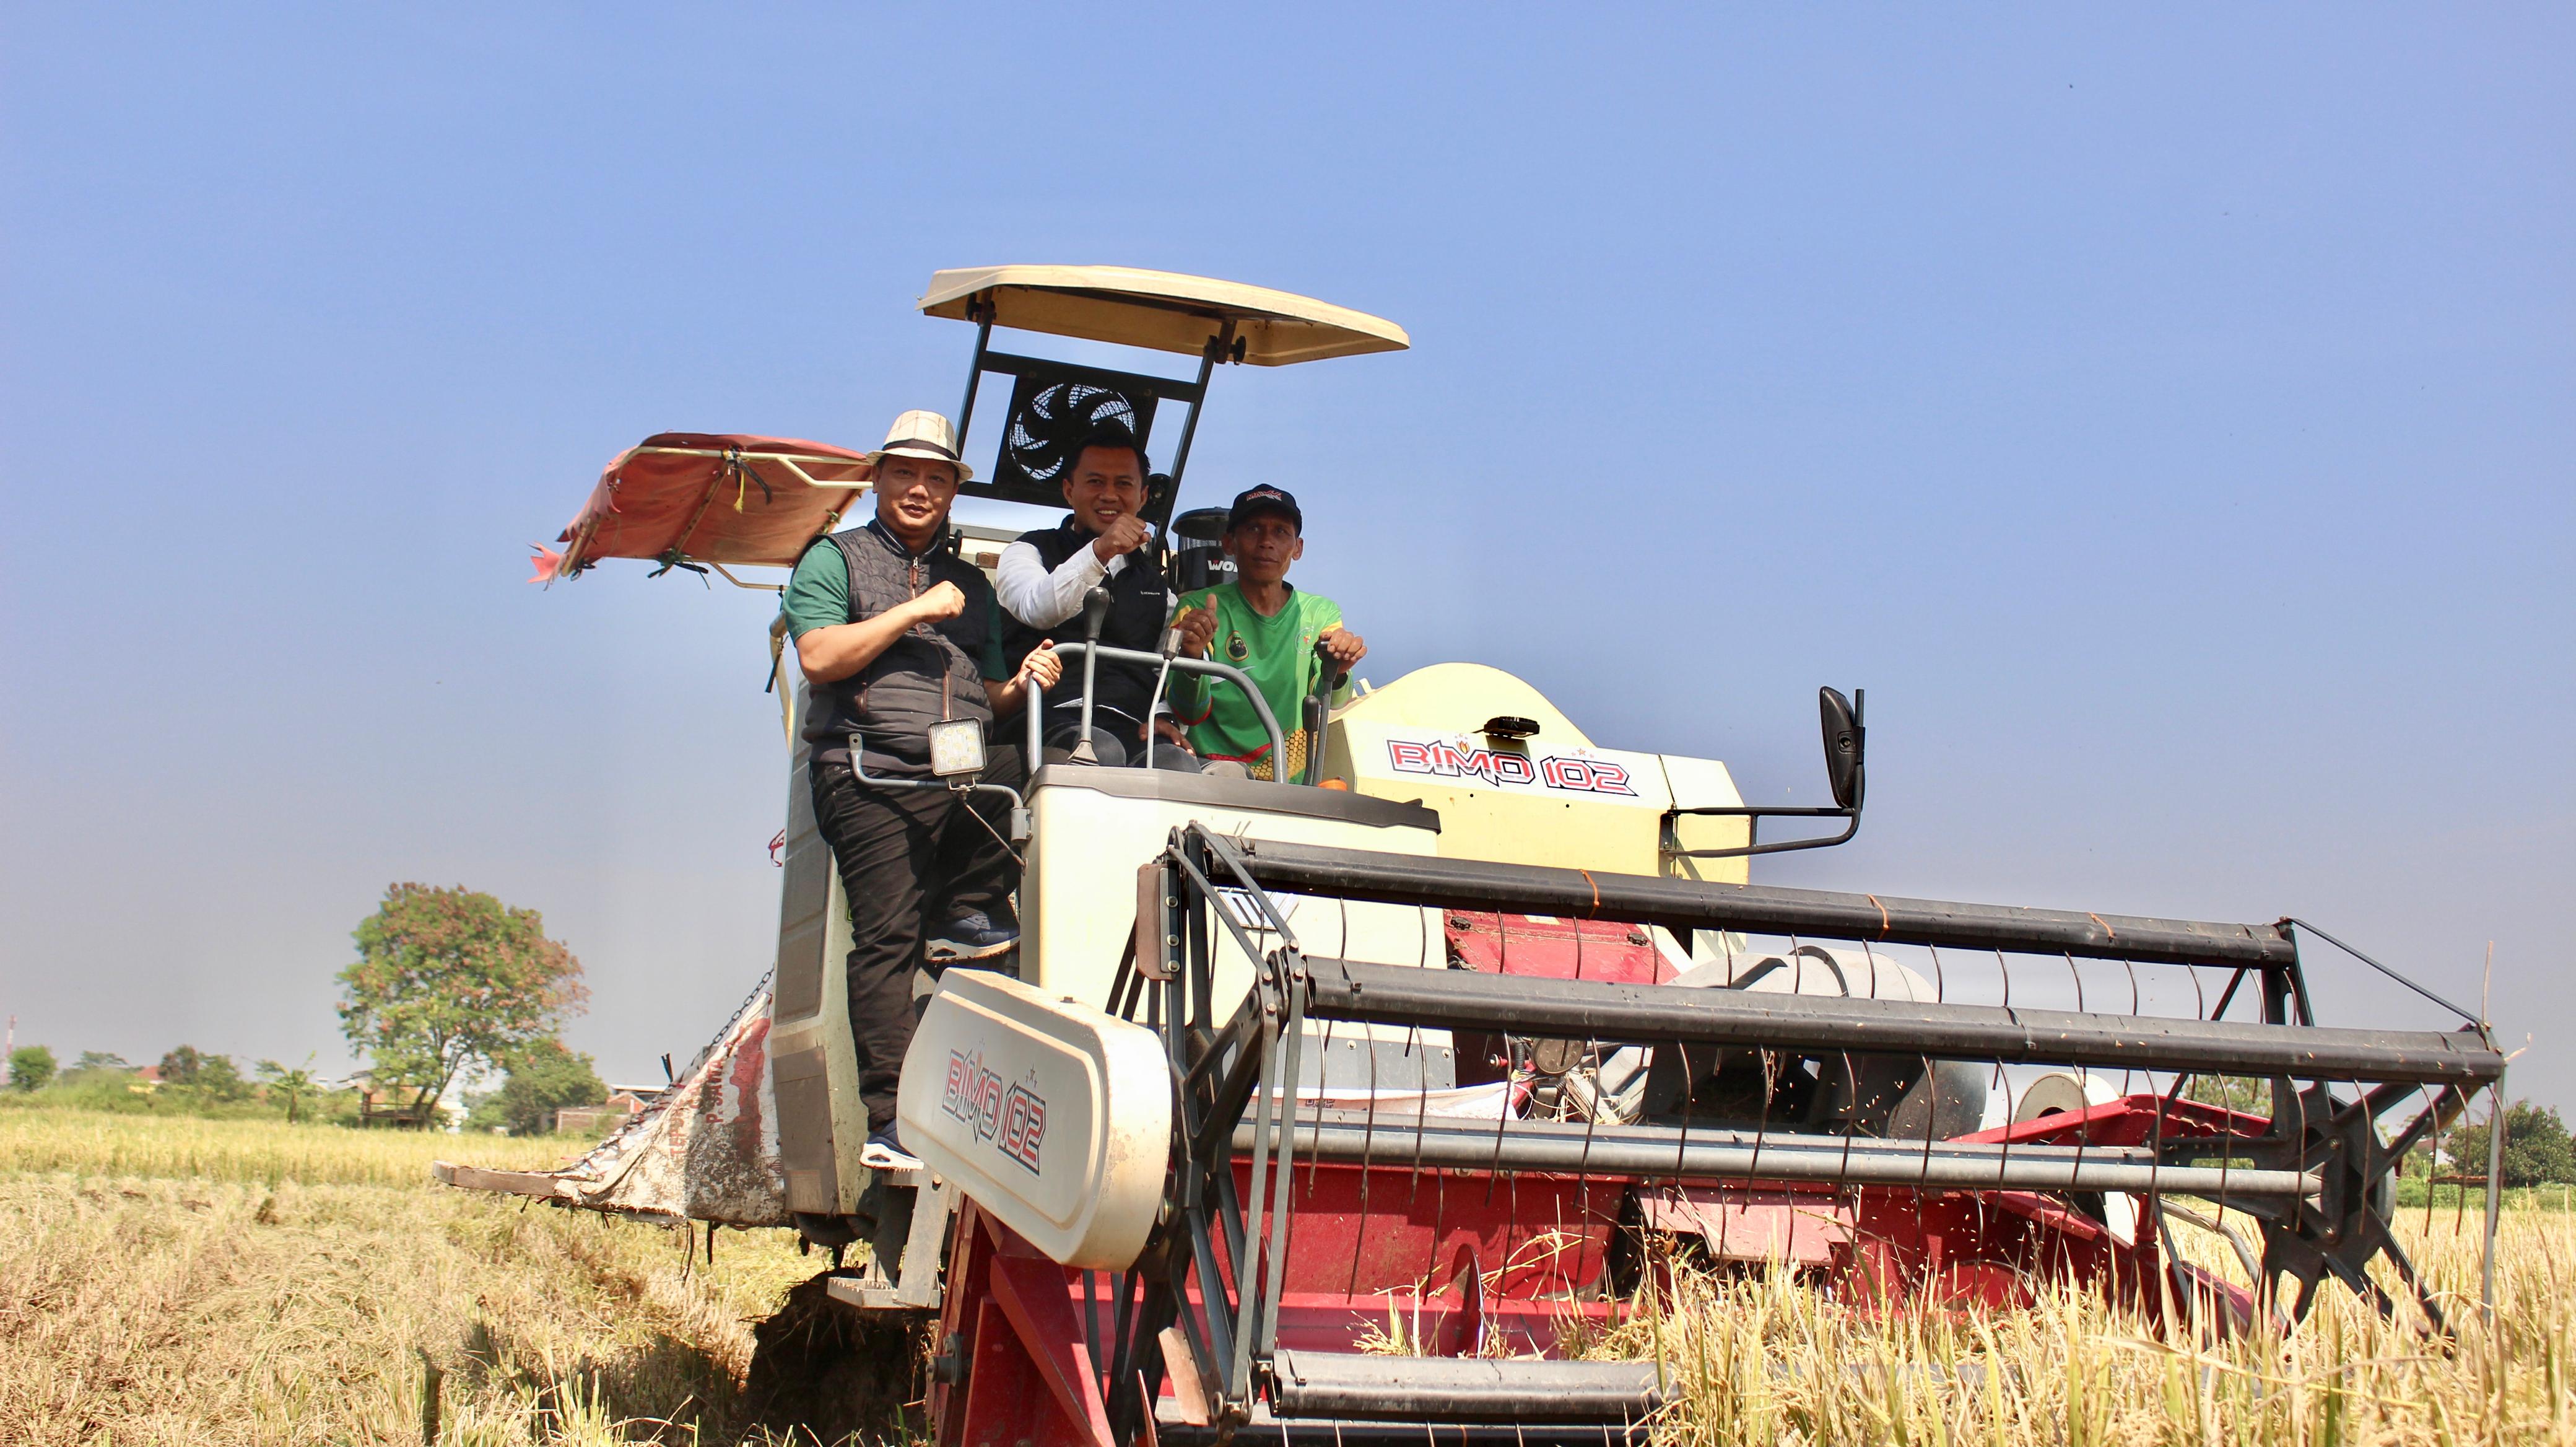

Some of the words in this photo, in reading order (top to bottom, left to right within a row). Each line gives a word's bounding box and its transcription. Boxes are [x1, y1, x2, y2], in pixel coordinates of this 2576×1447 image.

[1387, 739, 1536, 787] BIMO
[1540, 755, 1639, 797] 102
[941, 1048, 1003, 1145] BIMO
[998, 1080, 1046, 1176] 102
